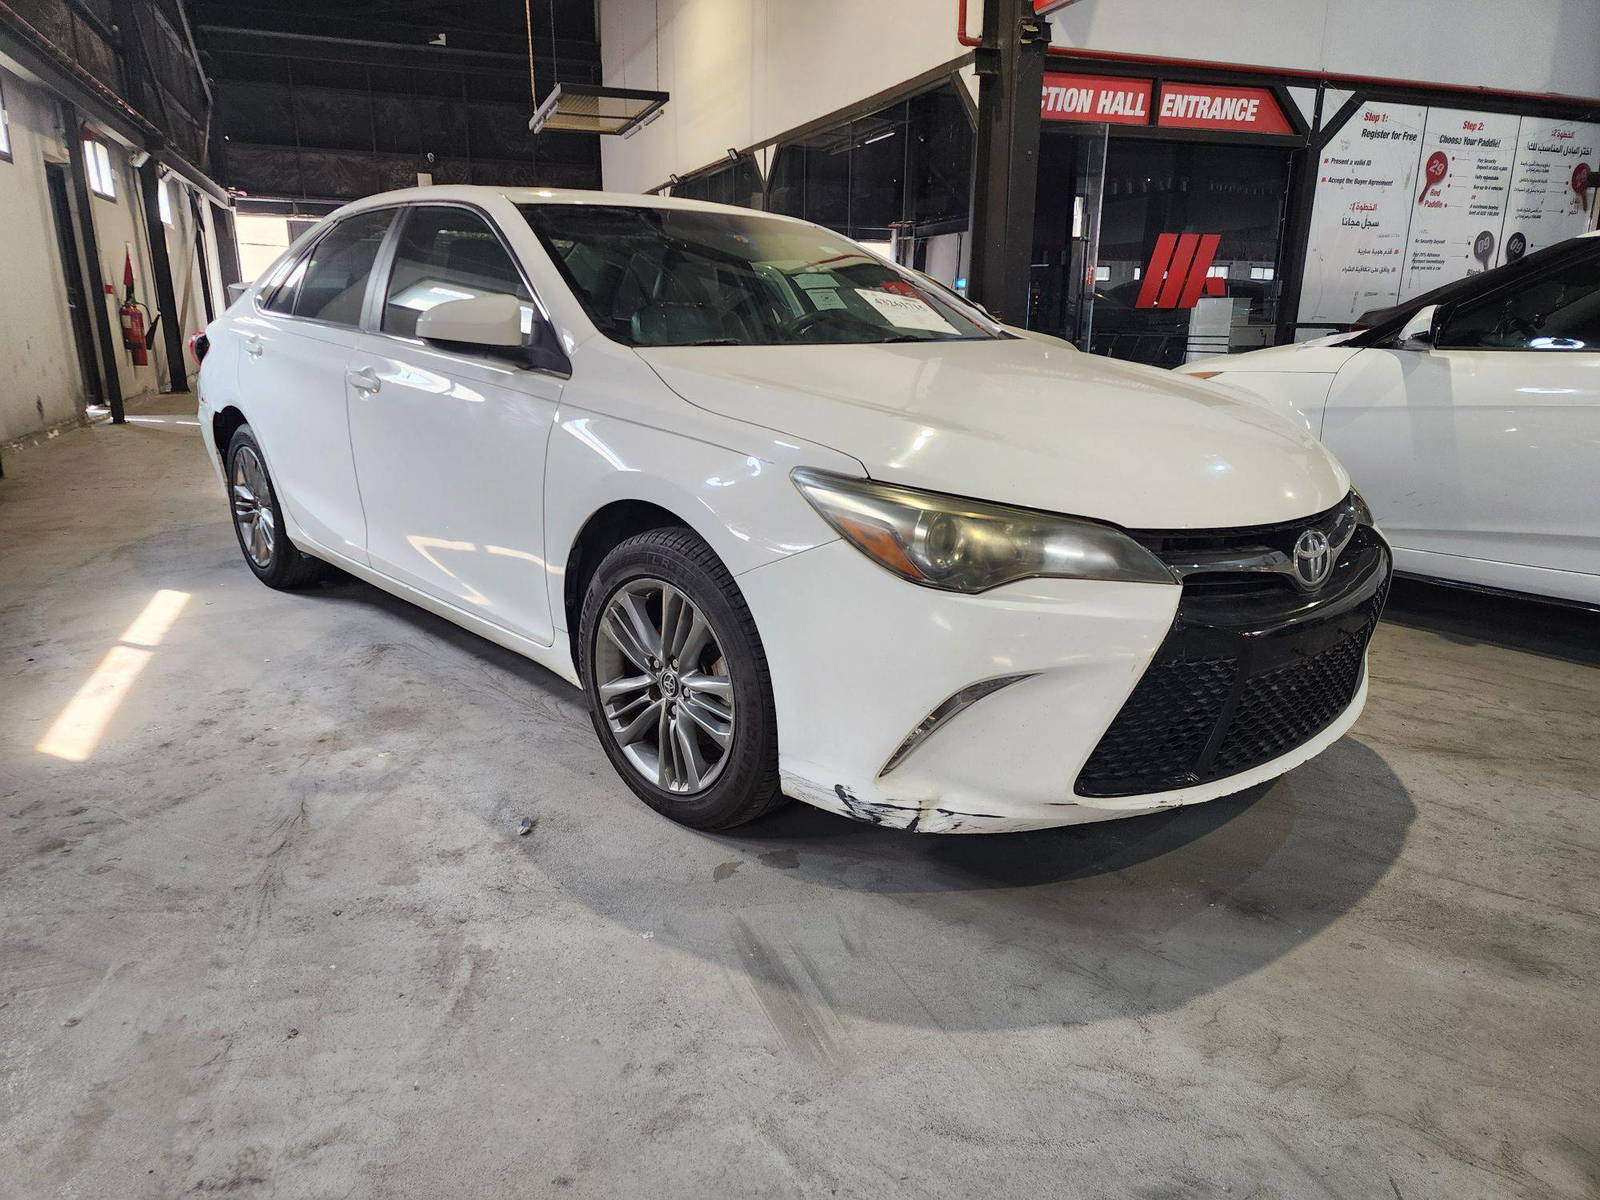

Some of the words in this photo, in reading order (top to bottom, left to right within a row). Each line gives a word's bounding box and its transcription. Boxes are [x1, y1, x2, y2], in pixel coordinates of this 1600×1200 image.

[1096, 90, 1146, 117] HALL
[1160, 93, 1260, 122] ENTRANCE
[1364, 112, 1379, 123] Step
[1463, 121, 1477, 131] Step
[1362, 129, 1389, 140] Register
[1391, 131, 1401, 140] for
[1402, 132, 1417, 141] Free
[1440, 135, 1462, 145] Choose
[1464, 137, 1477, 145] Your
